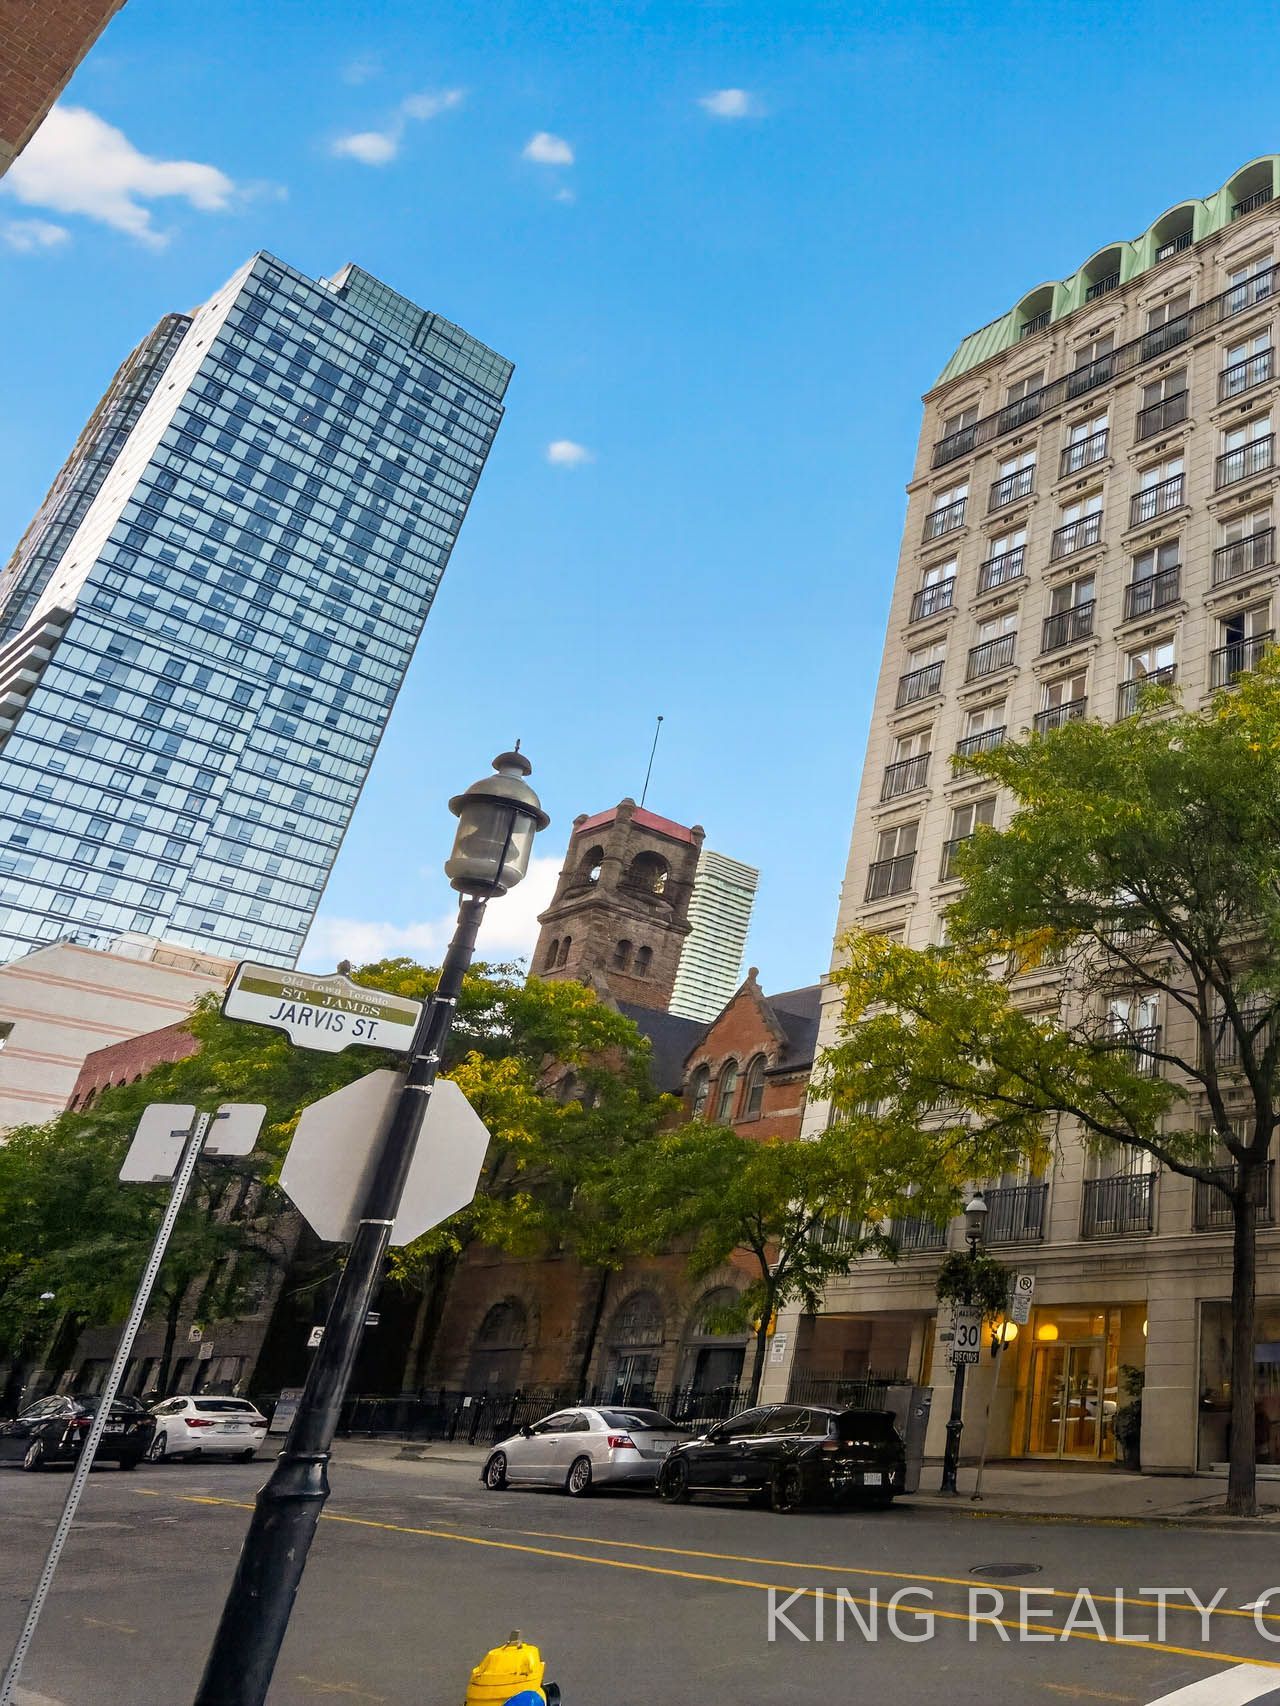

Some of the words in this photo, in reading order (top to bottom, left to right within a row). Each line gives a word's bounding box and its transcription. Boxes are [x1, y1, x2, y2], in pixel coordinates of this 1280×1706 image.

[281, 986, 310, 1001] ST.
[322, 996, 381, 1016] JAMES
[269, 1002, 346, 1032] JARVIS
[352, 1018, 379, 1041] ST.
[957, 1325, 978, 1346] 30
[953, 1351, 978, 1363] BEGINS
